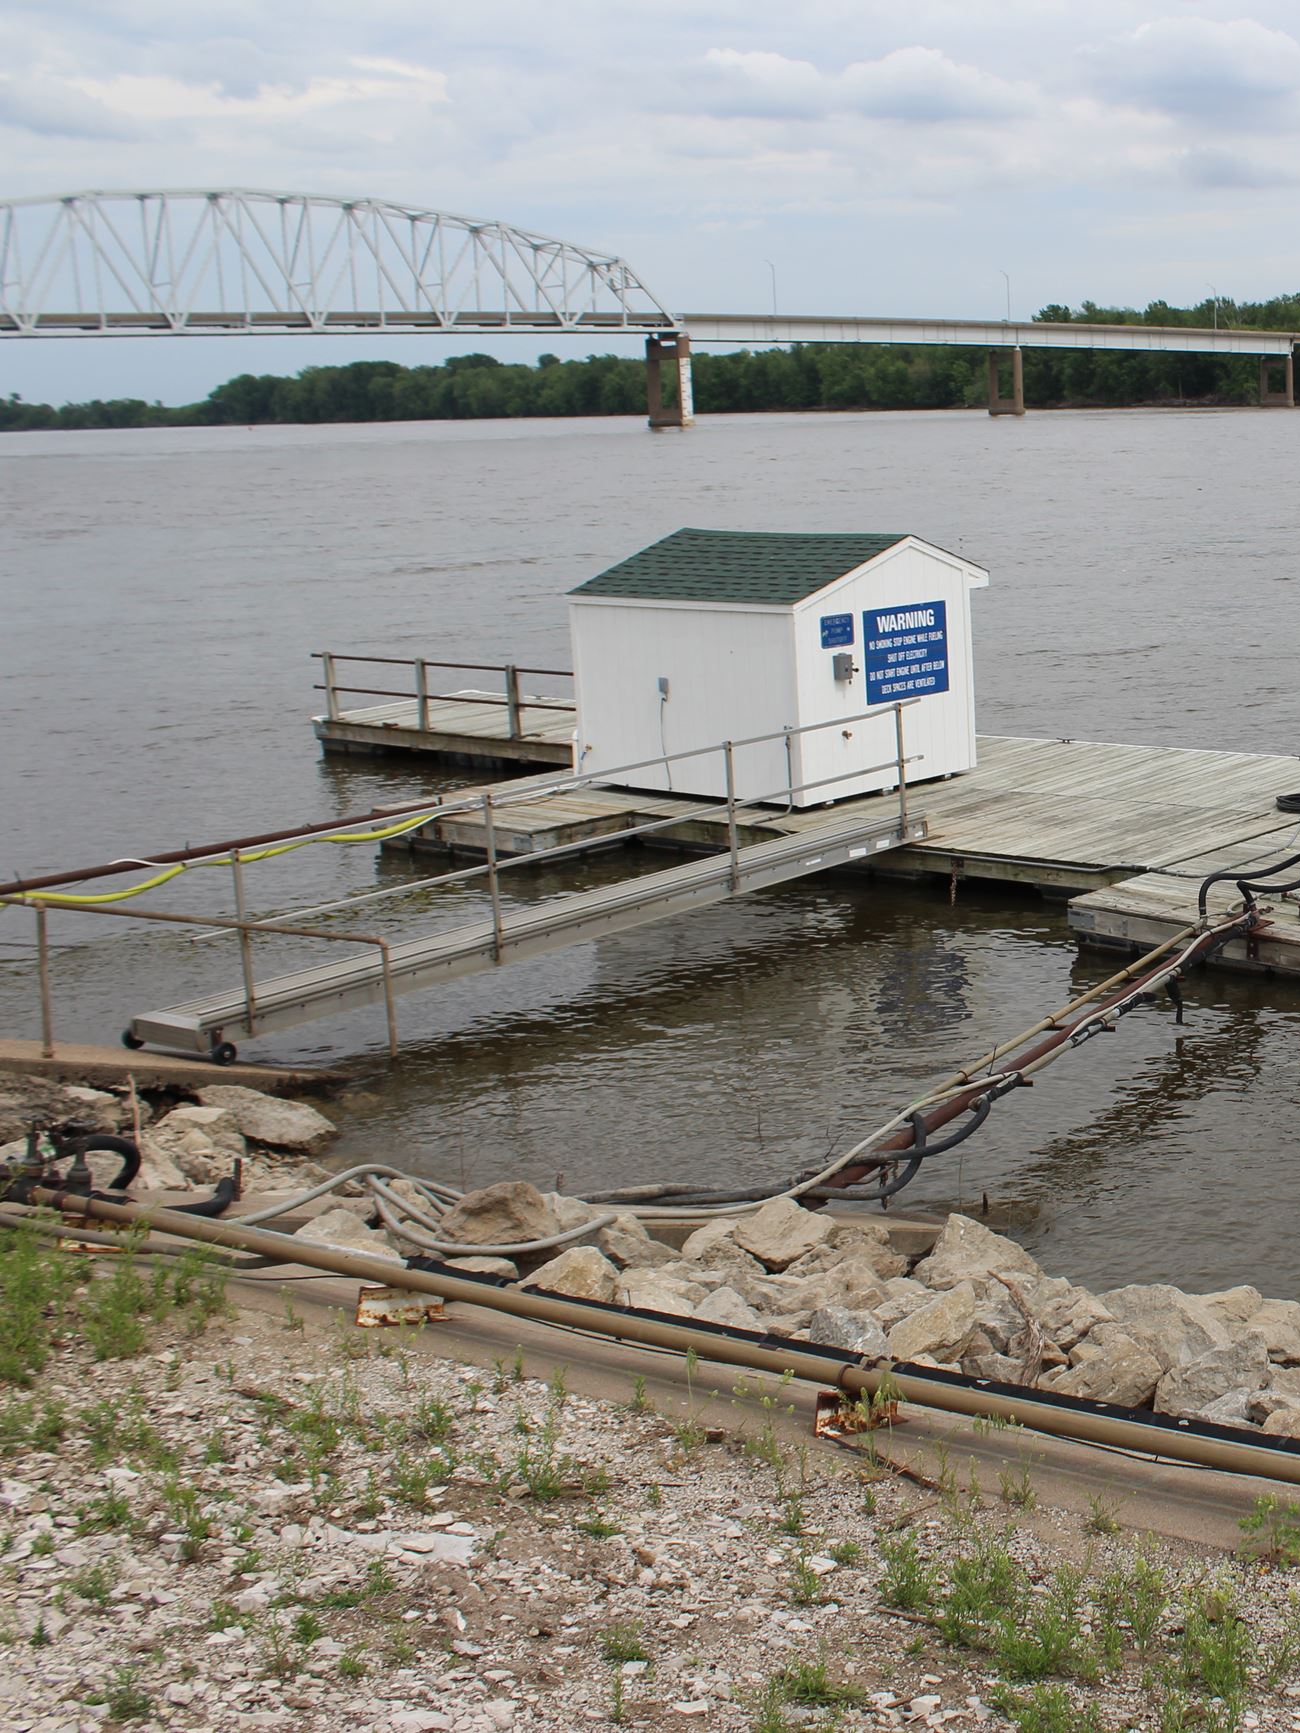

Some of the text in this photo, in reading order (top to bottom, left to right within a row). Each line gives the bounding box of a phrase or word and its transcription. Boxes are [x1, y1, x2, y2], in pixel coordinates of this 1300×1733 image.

[876, 608, 935, 633] WARNING
[868, 630, 944, 651] NO SMOKING STOP ENGINE WHILE FUELING
[887, 648, 928, 663] SHUT OFF ELECTRICITY
[869, 660, 945, 681] DO NOT START ENGINE UNTIL AFTER BELOW
[881, 676, 936, 695] DECK SPACES ARE VENTILATED
